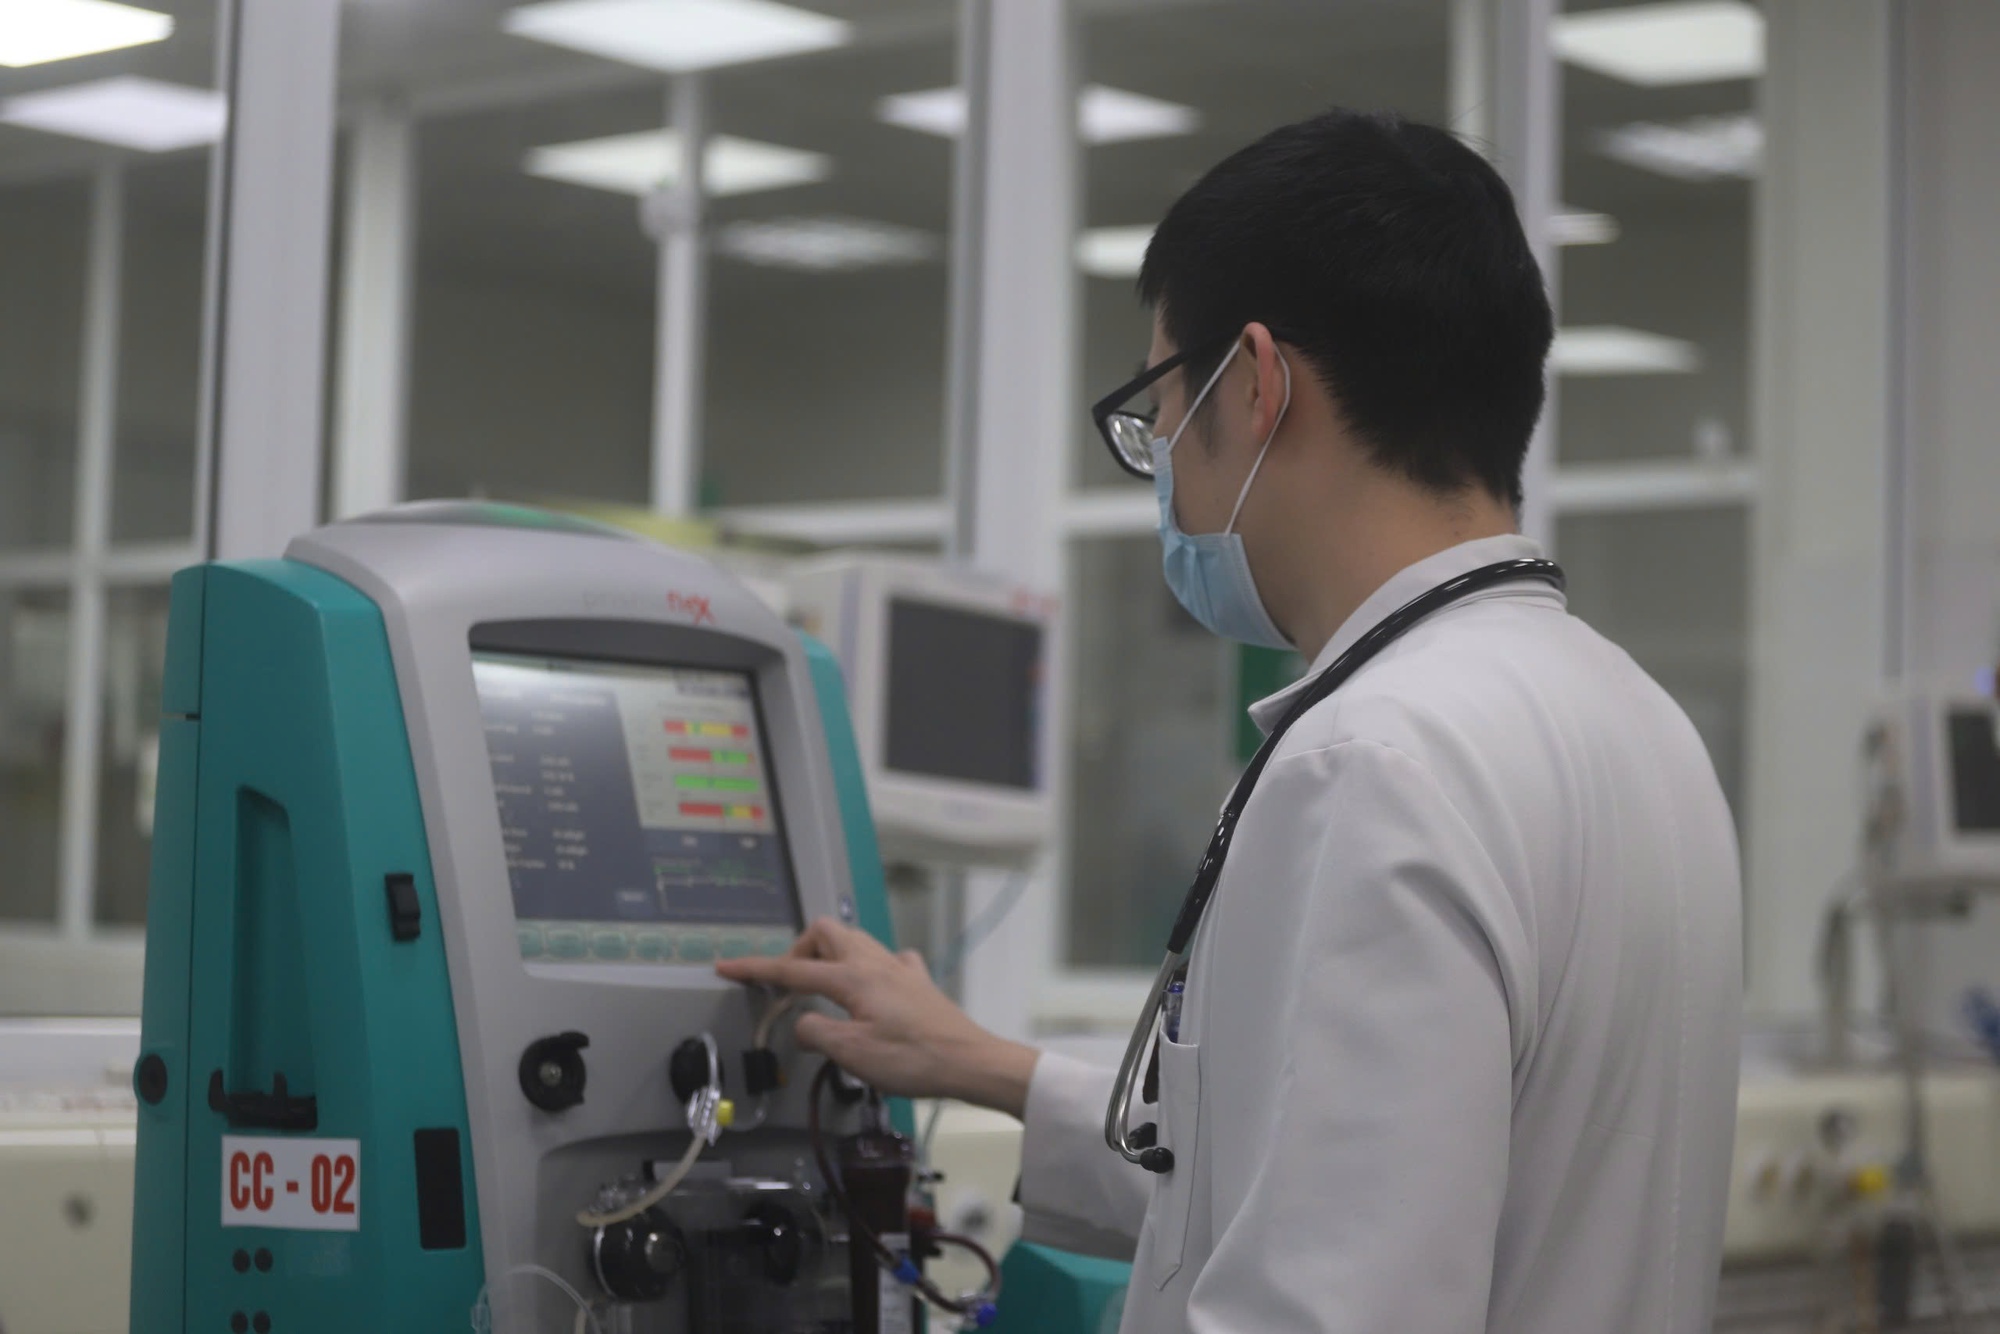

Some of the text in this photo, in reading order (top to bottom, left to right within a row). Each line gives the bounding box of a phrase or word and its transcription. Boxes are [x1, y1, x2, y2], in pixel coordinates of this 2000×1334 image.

[230, 1150, 356, 1214] CC - 02
